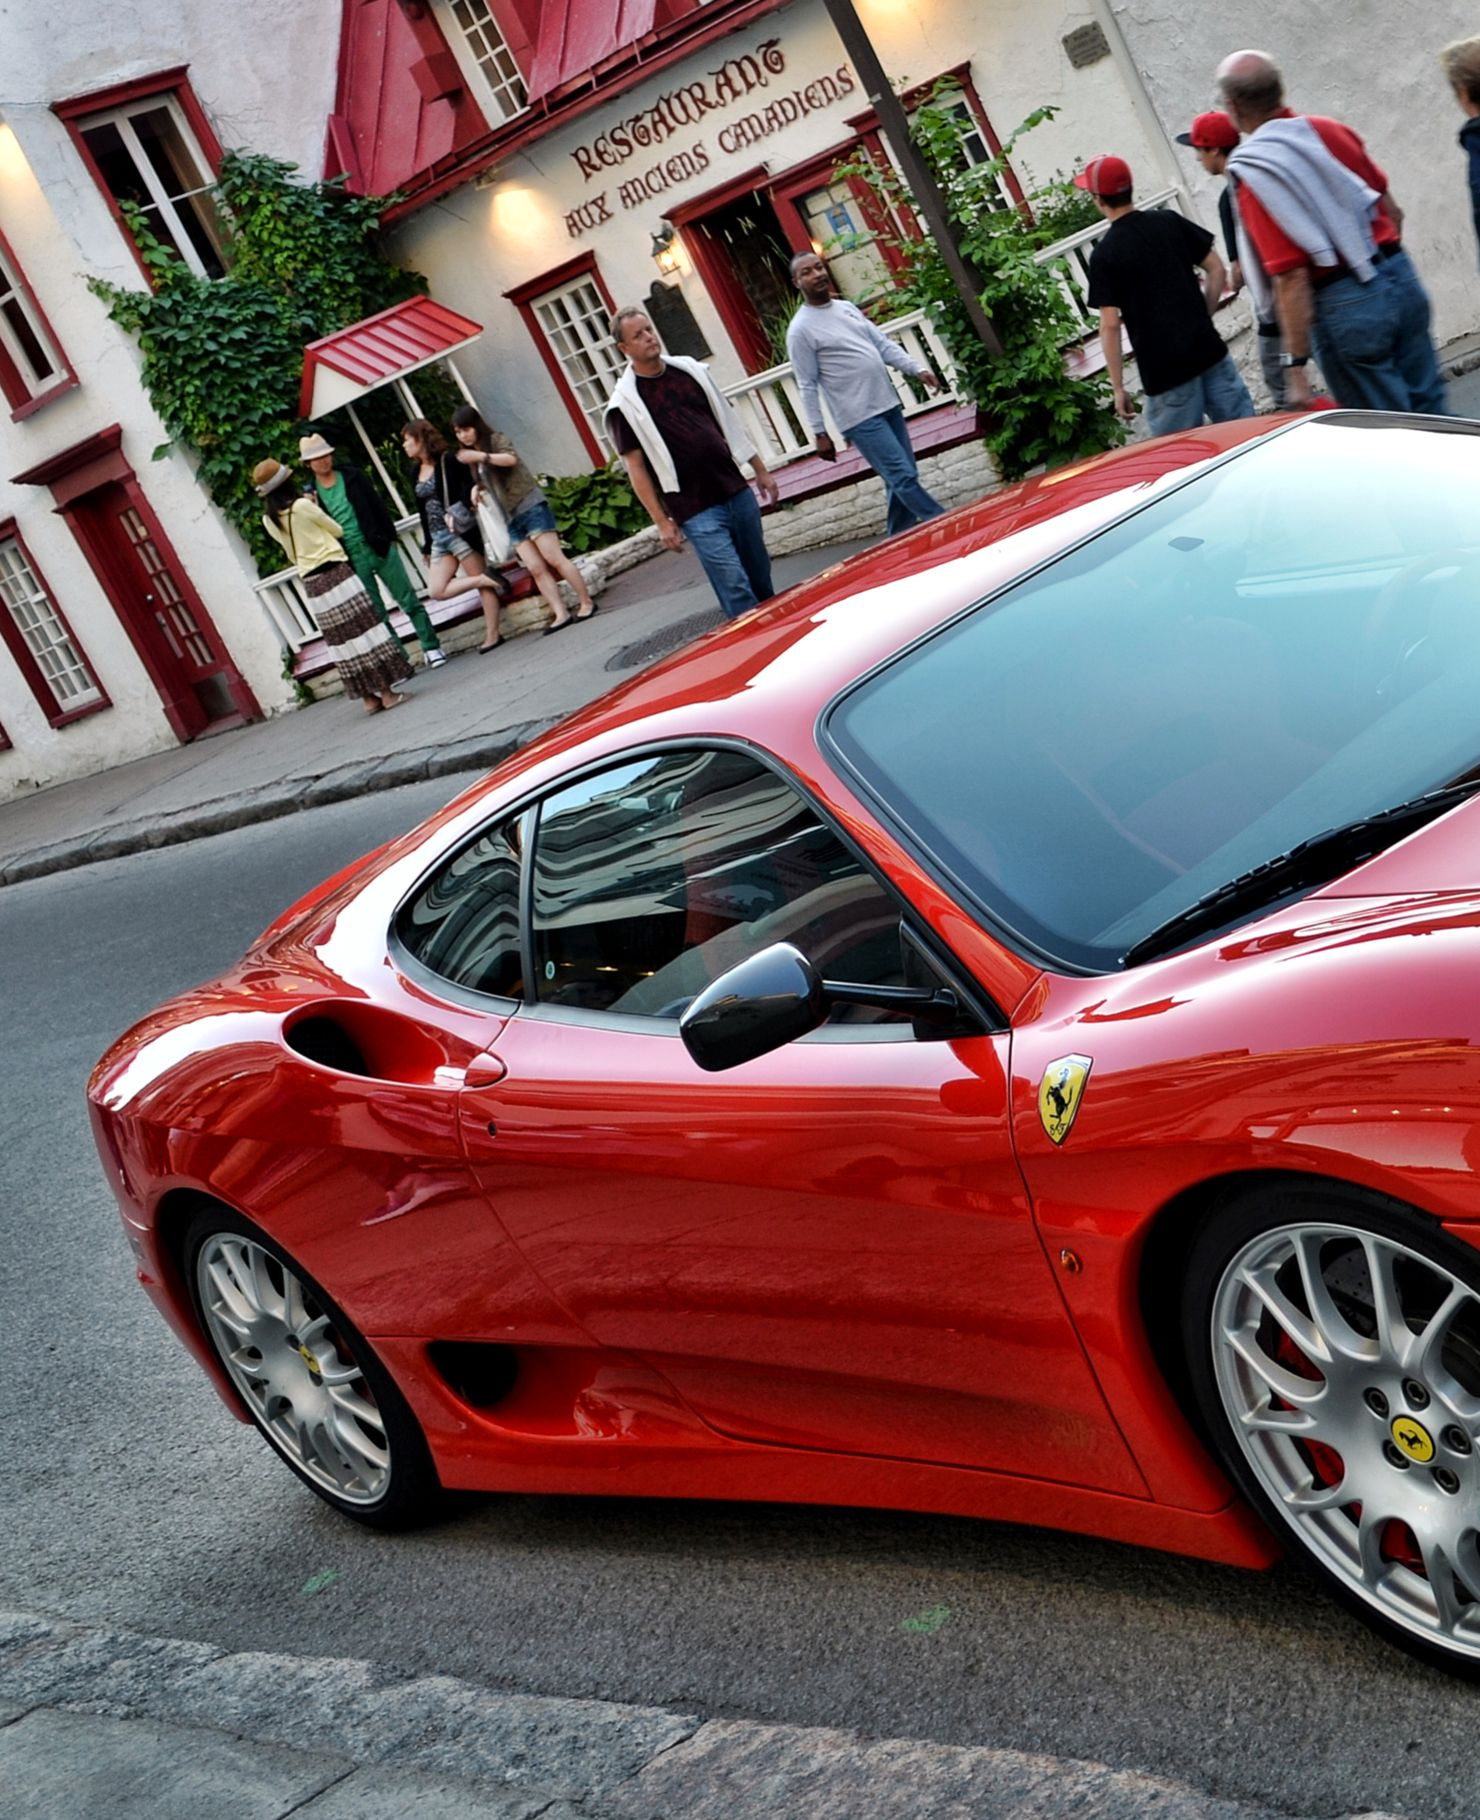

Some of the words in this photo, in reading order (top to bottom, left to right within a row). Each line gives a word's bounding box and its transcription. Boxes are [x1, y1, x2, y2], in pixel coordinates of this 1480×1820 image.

[563, 191, 614, 239] AUX
[616, 139, 711, 210] ANCIENS
[718, 63, 855, 155] CANADIENS
[570, 38, 785, 183] RESTAURANT
